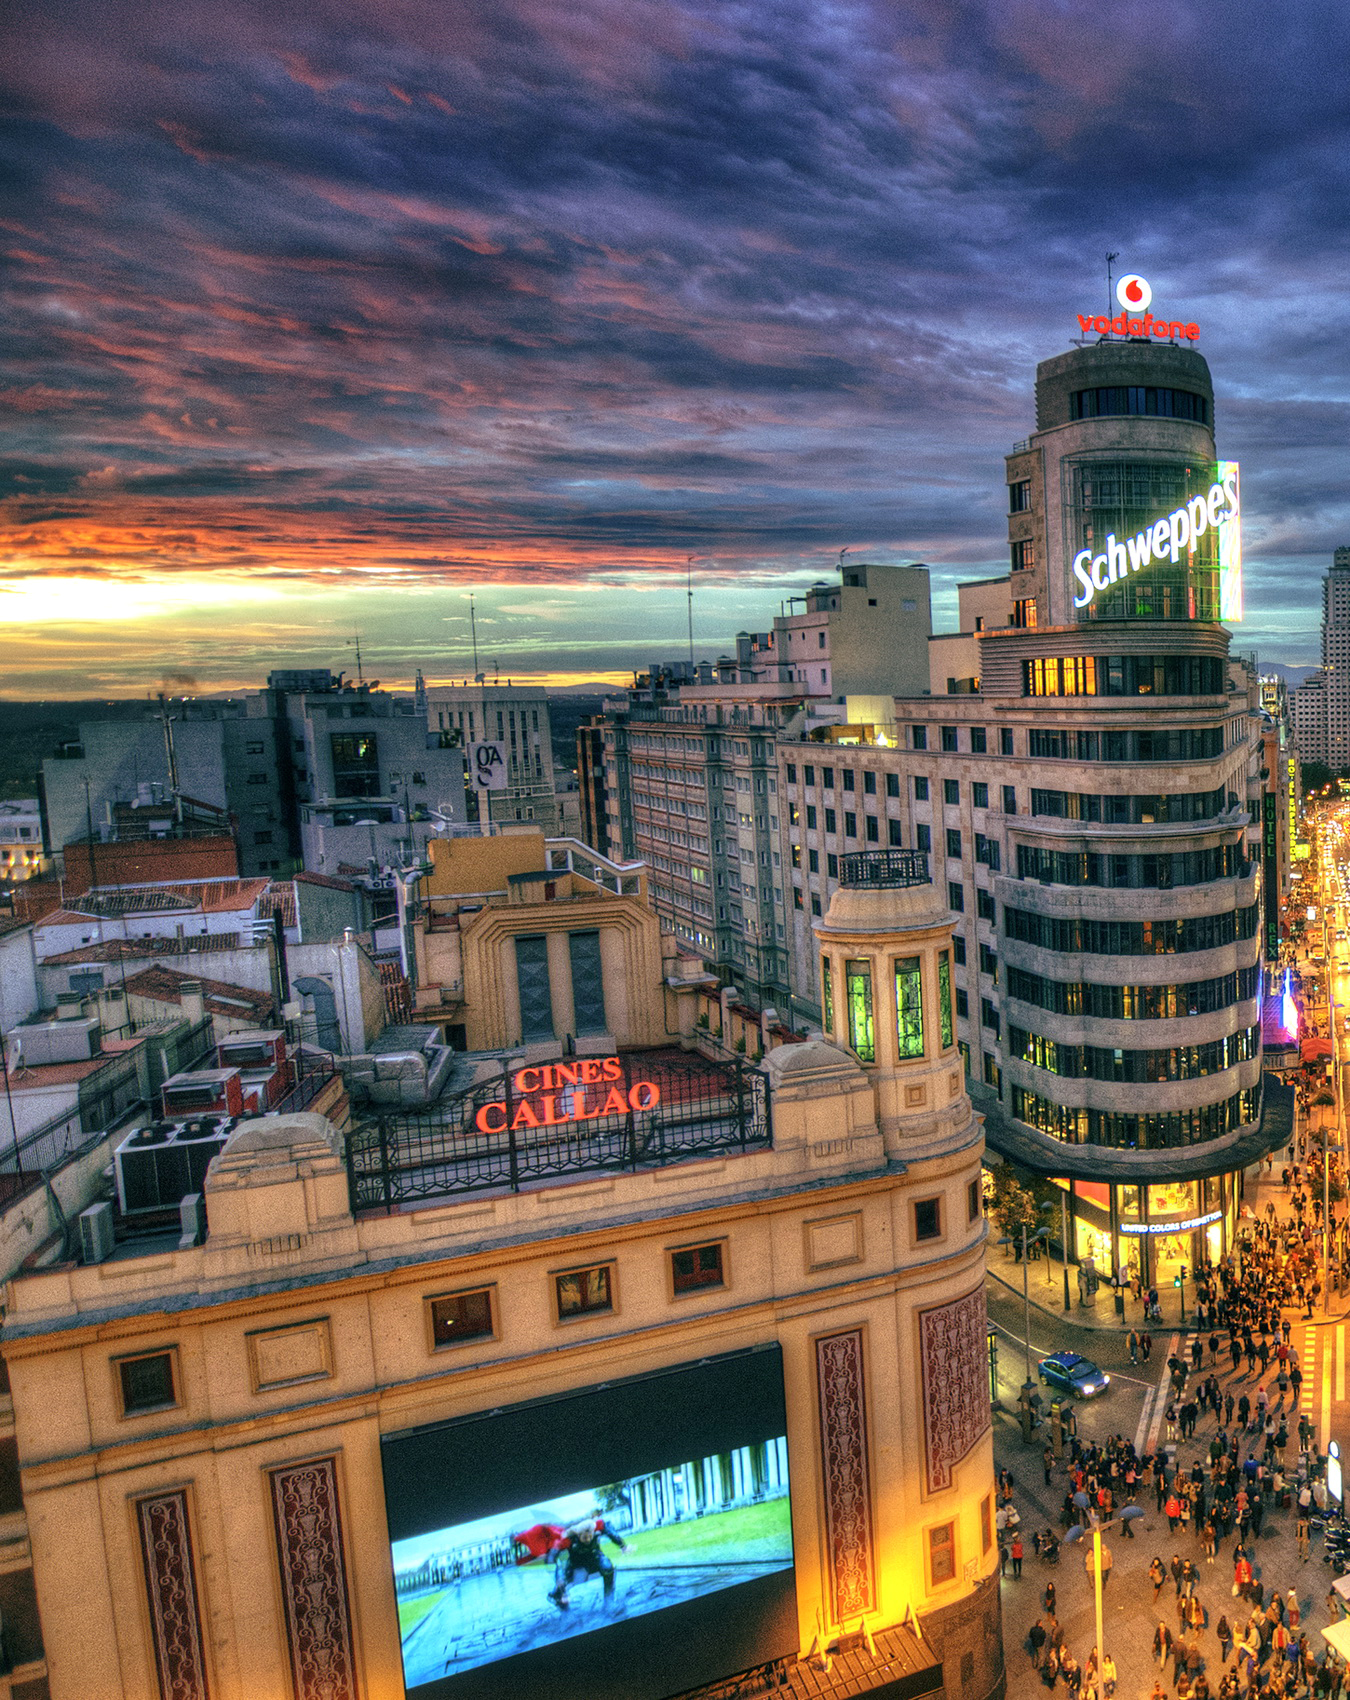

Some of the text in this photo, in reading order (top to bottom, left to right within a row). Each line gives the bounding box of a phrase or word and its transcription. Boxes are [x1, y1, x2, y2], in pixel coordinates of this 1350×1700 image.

[1077, 311, 1200, 340] vodafone
[1073, 474, 1238, 608] Schweppes
[1265, 799, 1278, 858] HOTEL
[1268, 922, 1278, 958] REX
[515, 1057, 622, 1093] CINES
[475, 1081, 661, 1134] CALLAO
